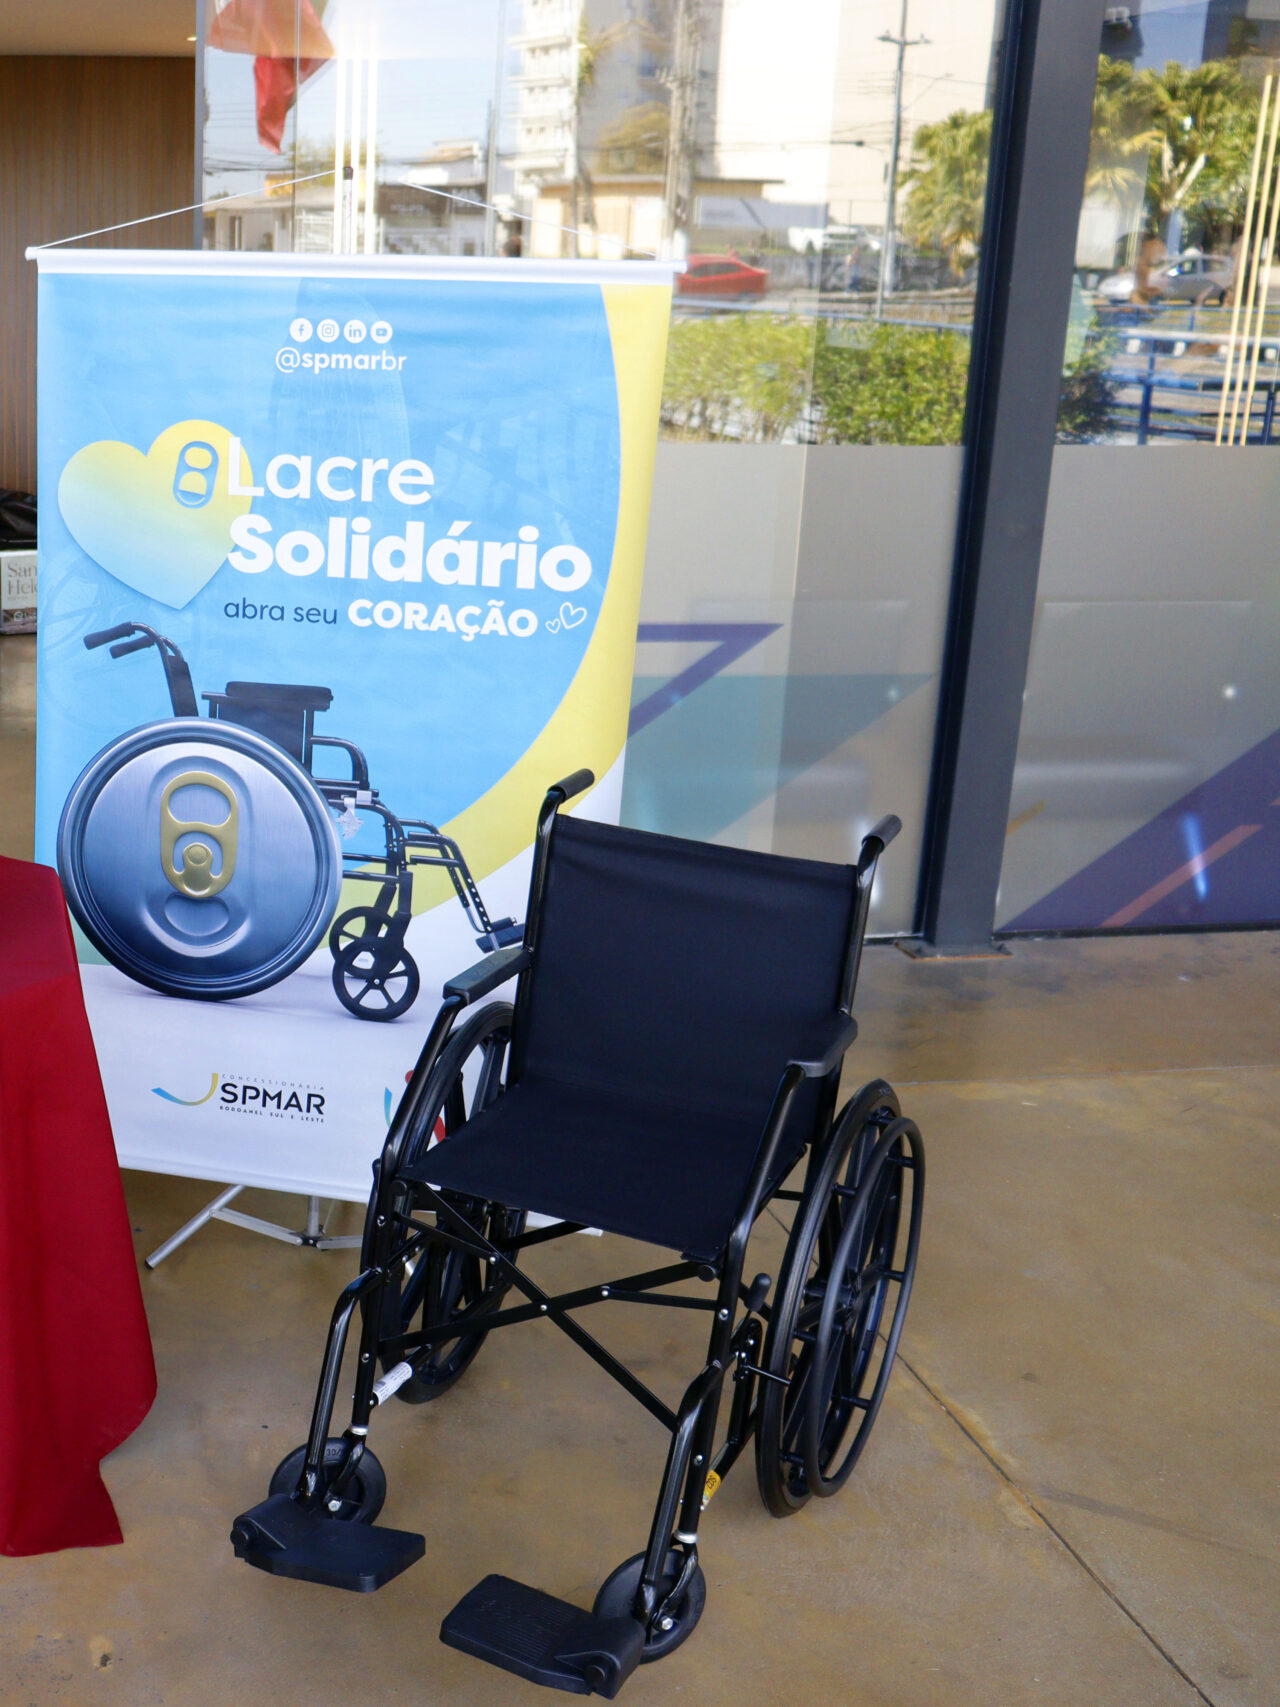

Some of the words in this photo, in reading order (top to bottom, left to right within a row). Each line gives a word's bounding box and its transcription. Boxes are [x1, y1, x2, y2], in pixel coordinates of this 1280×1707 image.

[275, 346, 407, 375] @spmarbr
[228, 436, 435, 505] Lacre
[227, 513, 593, 592] Solidário
[223, 597, 285, 621] abra
[293, 605, 338, 625] seu
[347, 598, 538, 642] CORAÇÃO
[220, 1082, 325, 1115] SPMAR
